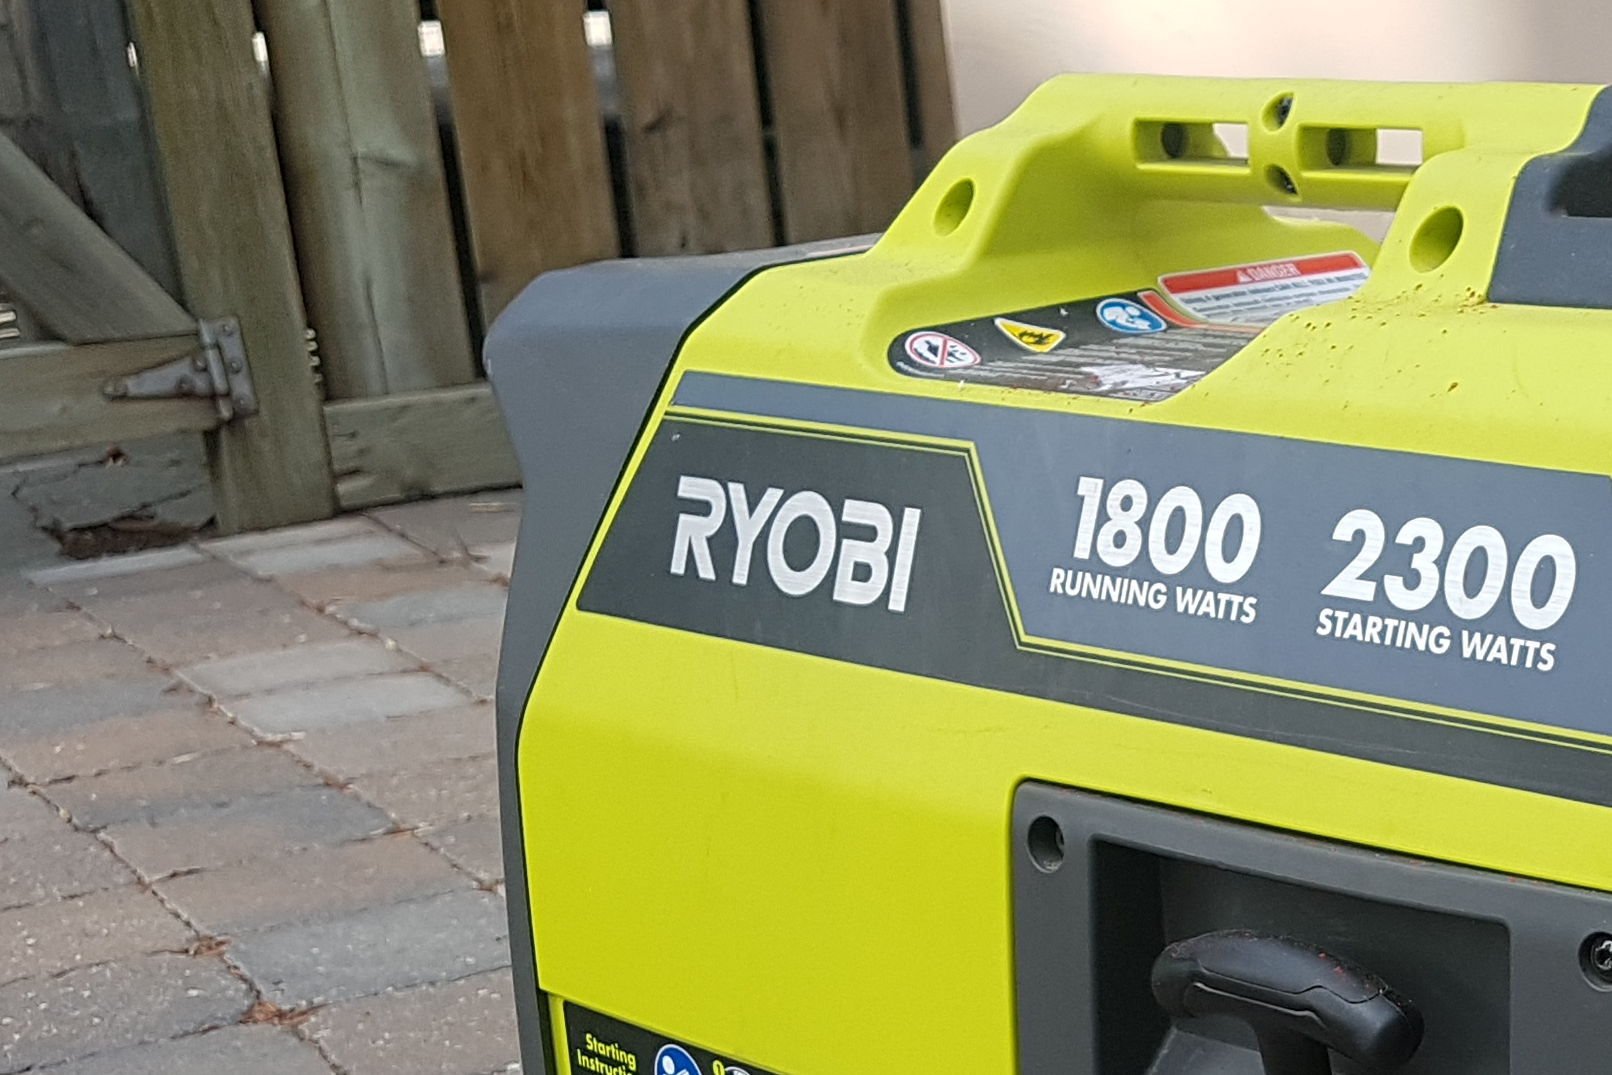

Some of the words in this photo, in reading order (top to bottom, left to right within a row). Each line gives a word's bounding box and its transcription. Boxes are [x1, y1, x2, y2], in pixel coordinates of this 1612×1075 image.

[669, 474, 922, 613] RYOBI
[1072, 475, 1262, 585] 1800
[1319, 508, 1577, 631] 2300
[1049, 567, 1169, 611] RUNNING
[1174, 586, 1258, 625] WATTS
[1316, 607, 1451, 654] STARTING
[1462, 628, 1556, 672] WATTS
[585, 1033, 637, 1071] Starting
